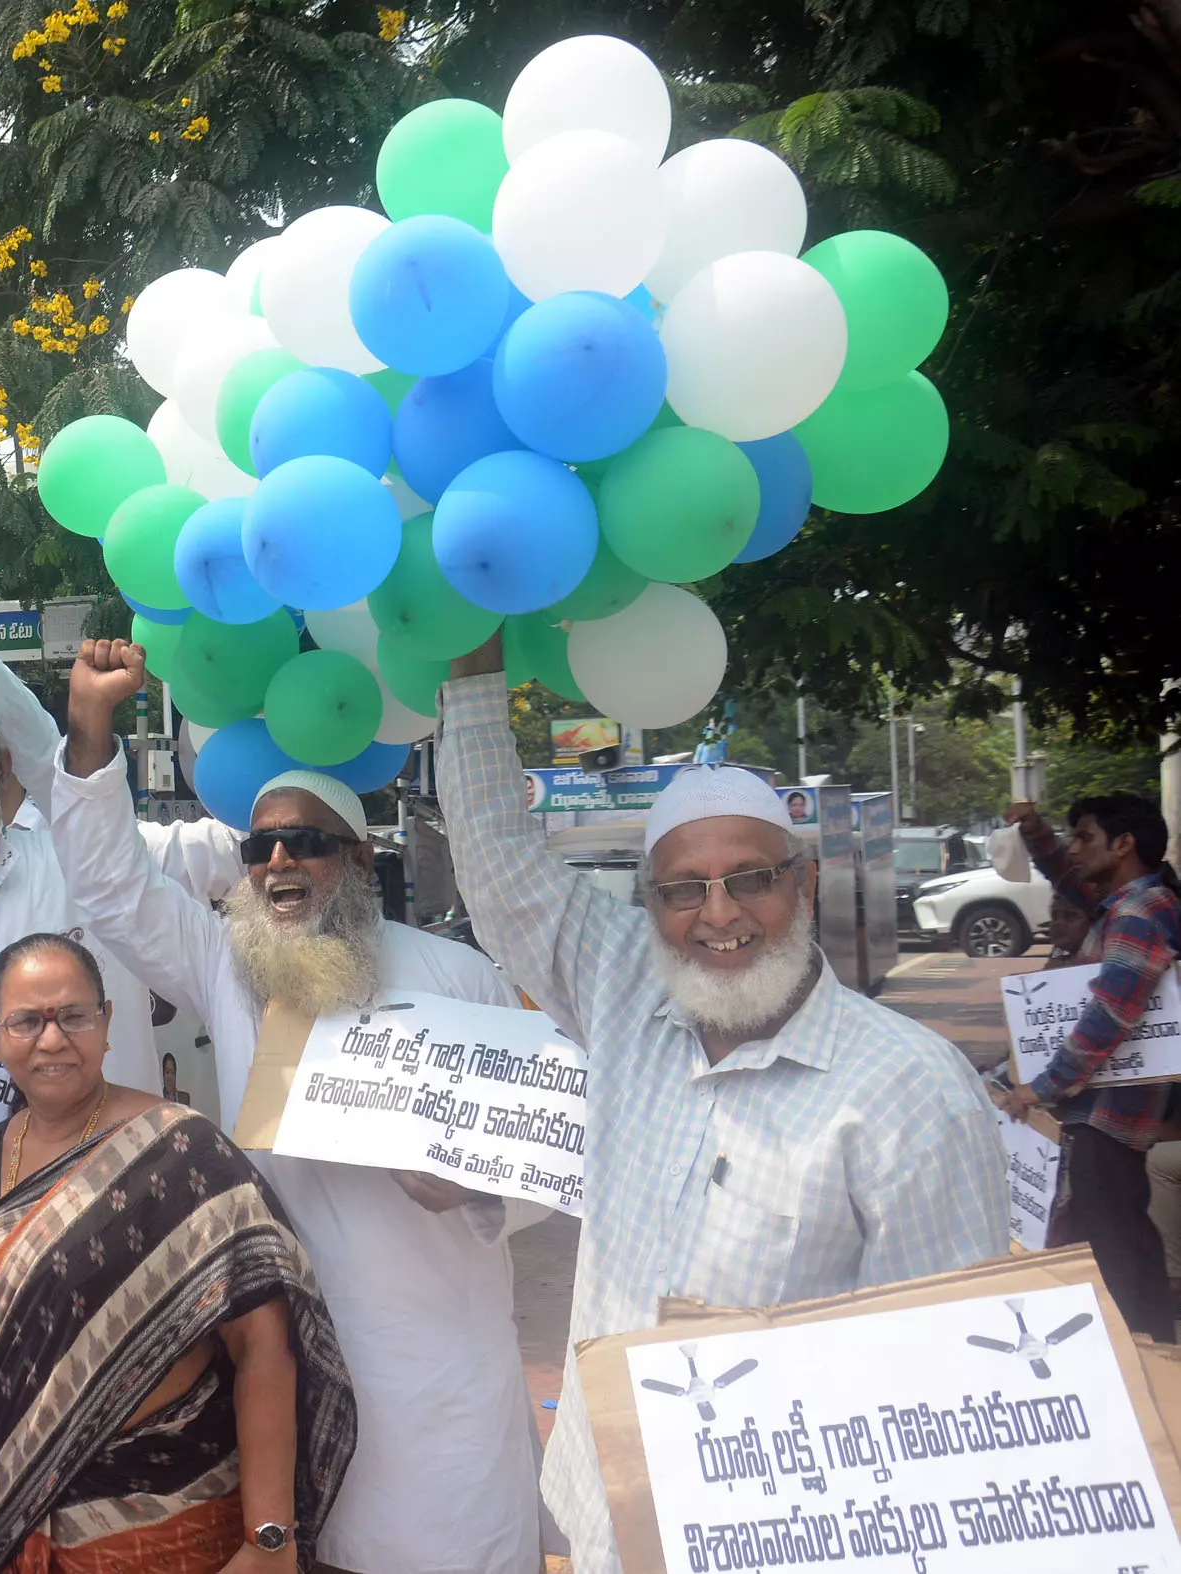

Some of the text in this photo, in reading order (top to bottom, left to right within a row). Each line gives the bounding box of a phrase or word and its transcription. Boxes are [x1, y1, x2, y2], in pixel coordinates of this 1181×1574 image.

[341, 1026, 393, 1069] ఝాన్సీ
[467, 1043, 587, 1099] గెలిపించుకుందా
[695, 1416, 777, 1495] ఝాన్సీ
[878, 1390, 1091, 1463] గెలిపించుకుందాం
[950, 1475, 1155, 1548] కాపాడుకుందాం
